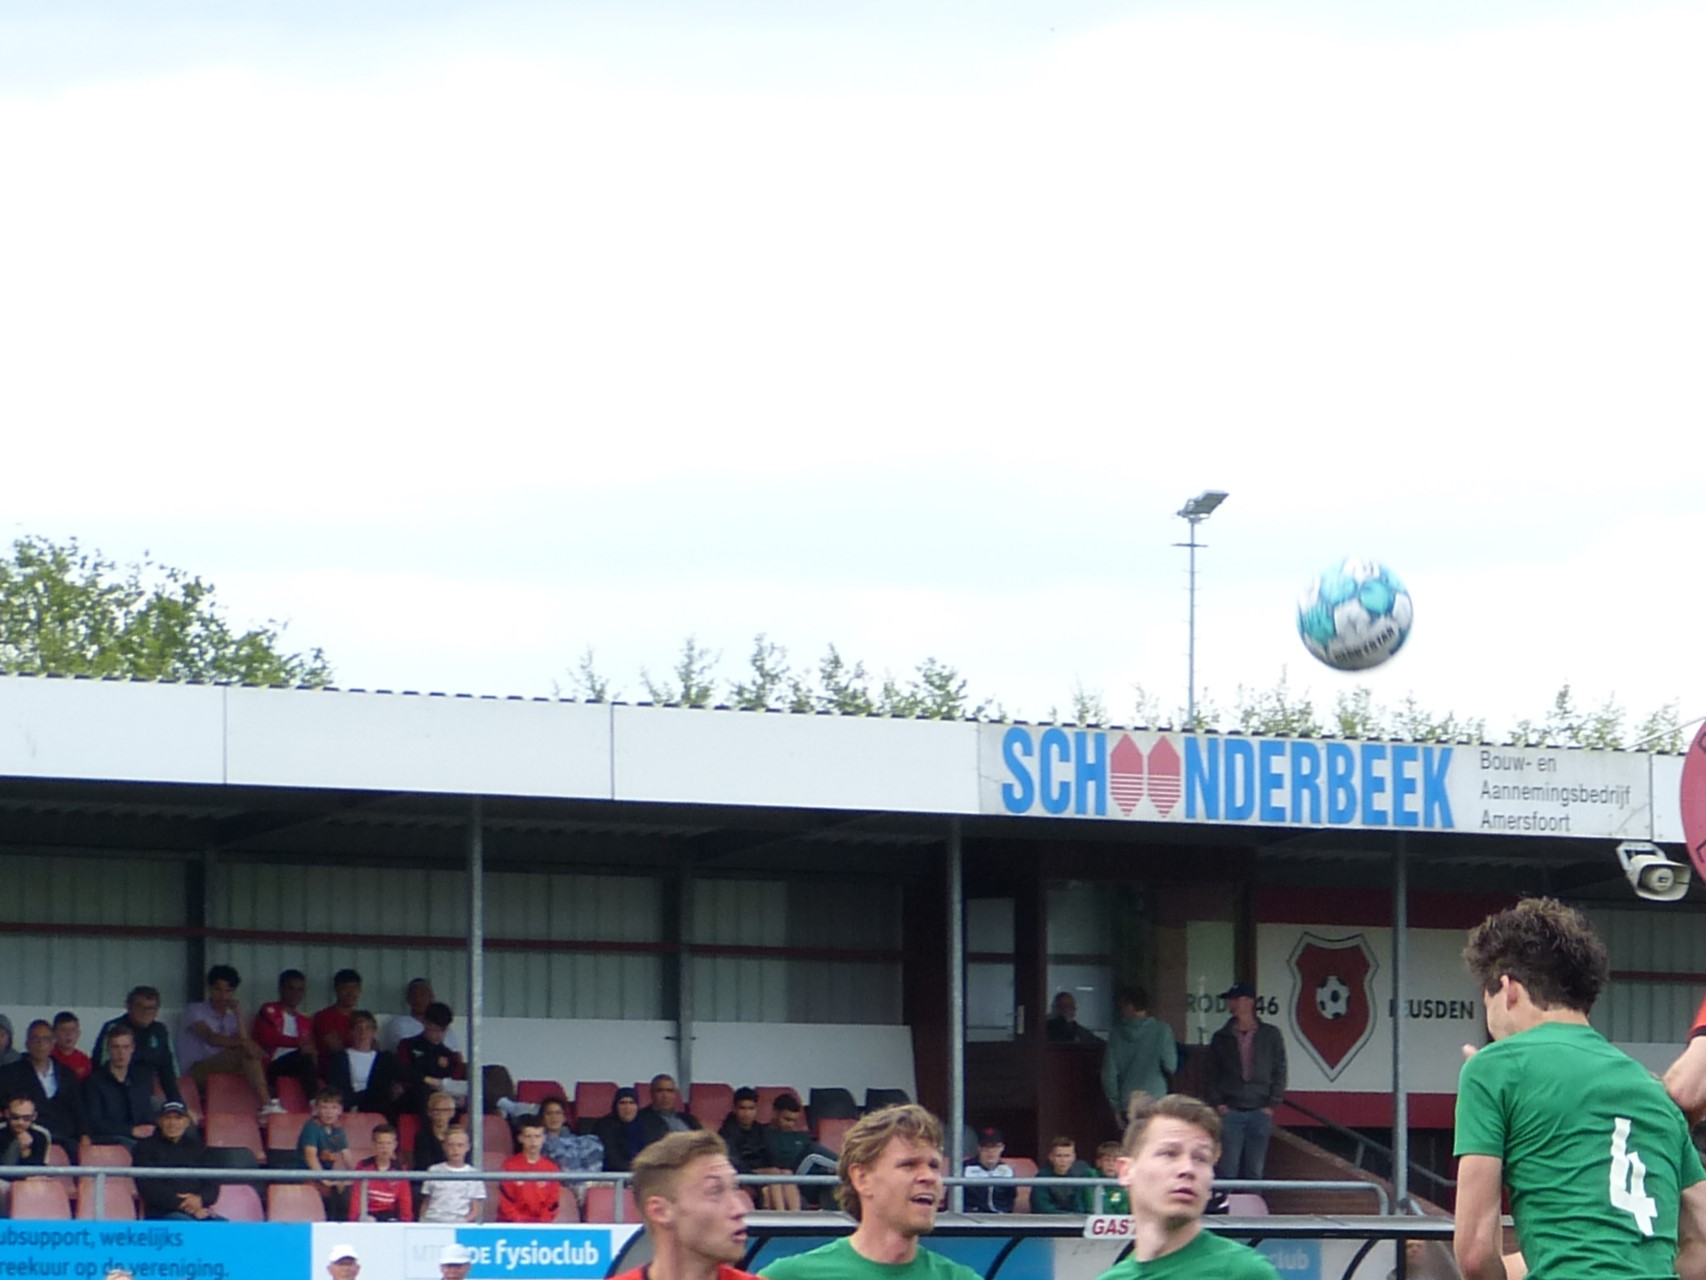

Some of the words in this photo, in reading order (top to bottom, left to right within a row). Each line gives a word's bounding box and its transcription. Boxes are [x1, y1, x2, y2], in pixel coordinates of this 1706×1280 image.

[1480, 750, 1532, 771] Bouw-
[1537, 756, 1557, 772] en
[1480, 779, 1631, 810] Aannemingsbedrijf
[1480, 809, 1572, 832] Amersfoort
[1186, 993, 1226, 1013] ROD
[1609, 1116, 1658, 1236] 4
[99, 1226, 184, 1251] wekelijks
[495, 1238, 599, 1270] fysioclub
[74, 1261, 98, 1280] op
